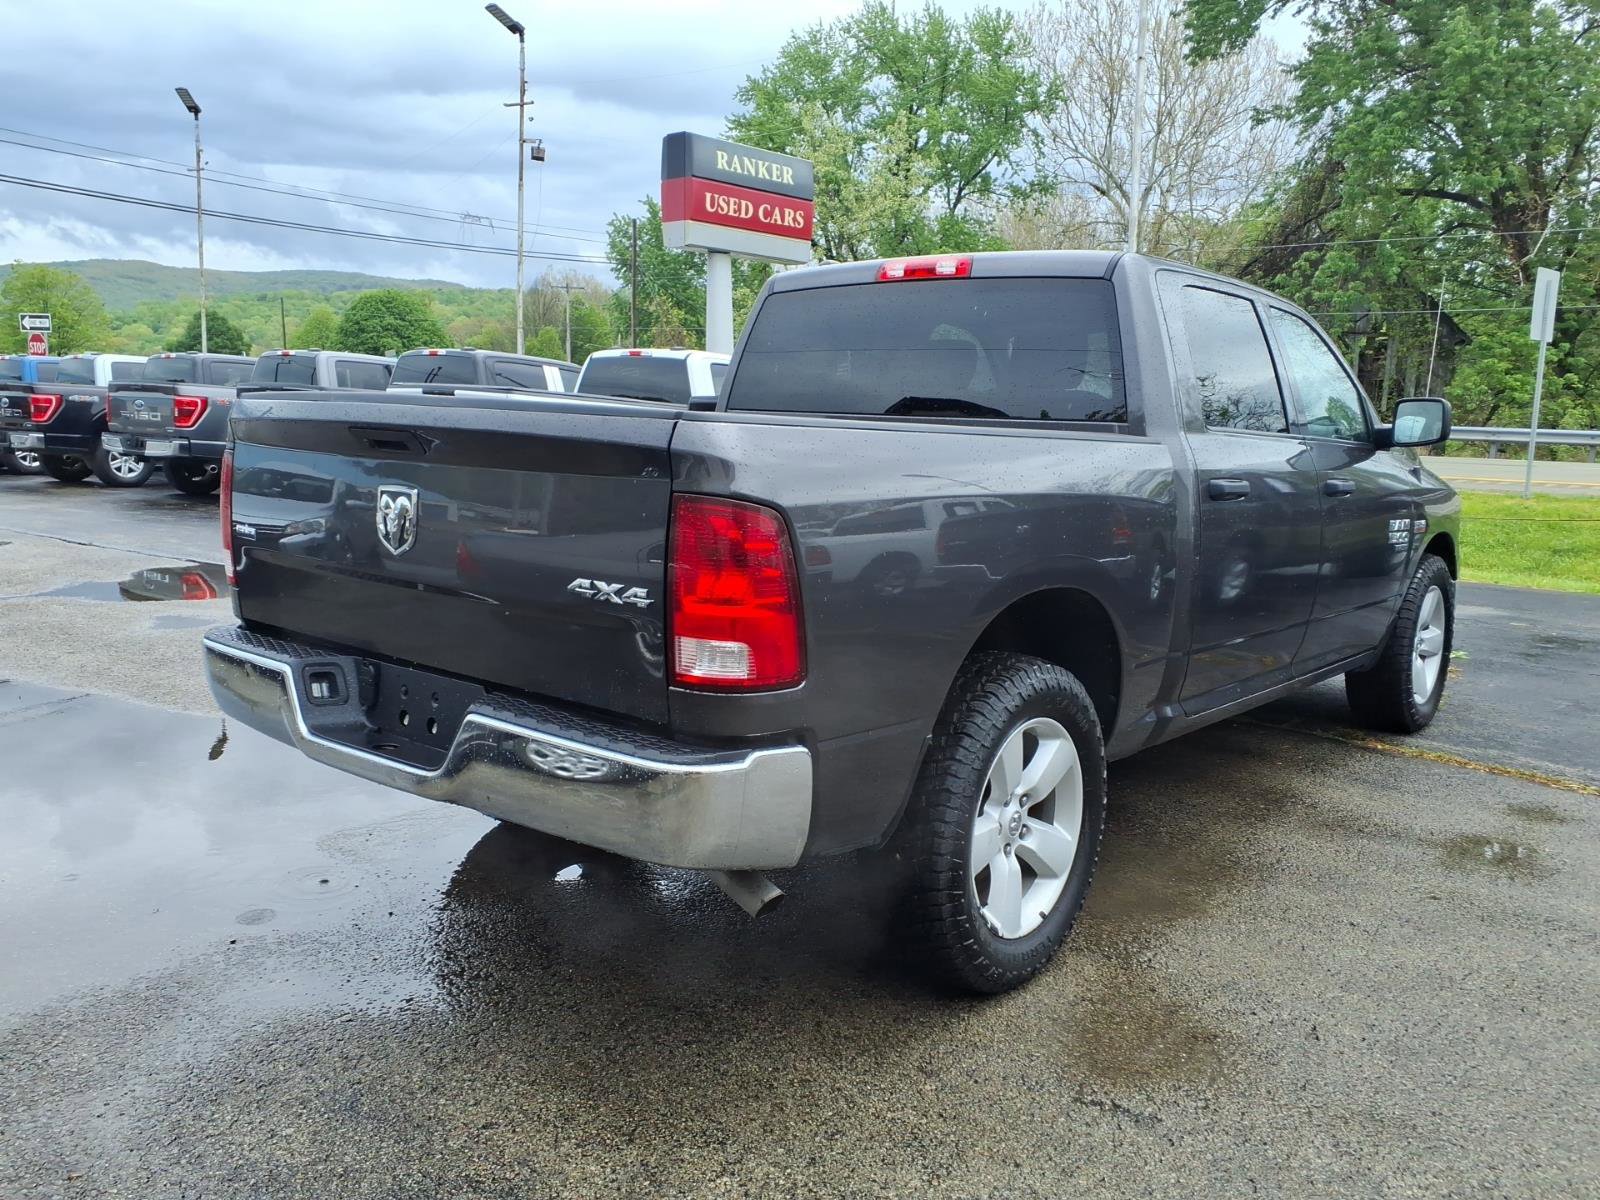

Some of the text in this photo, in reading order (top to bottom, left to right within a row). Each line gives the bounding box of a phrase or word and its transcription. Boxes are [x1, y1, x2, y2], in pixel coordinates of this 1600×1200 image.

[716, 150, 794, 185] RANKER
[704, 191, 805, 229] USED CARS
[30, 341, 46, 354] STOP
